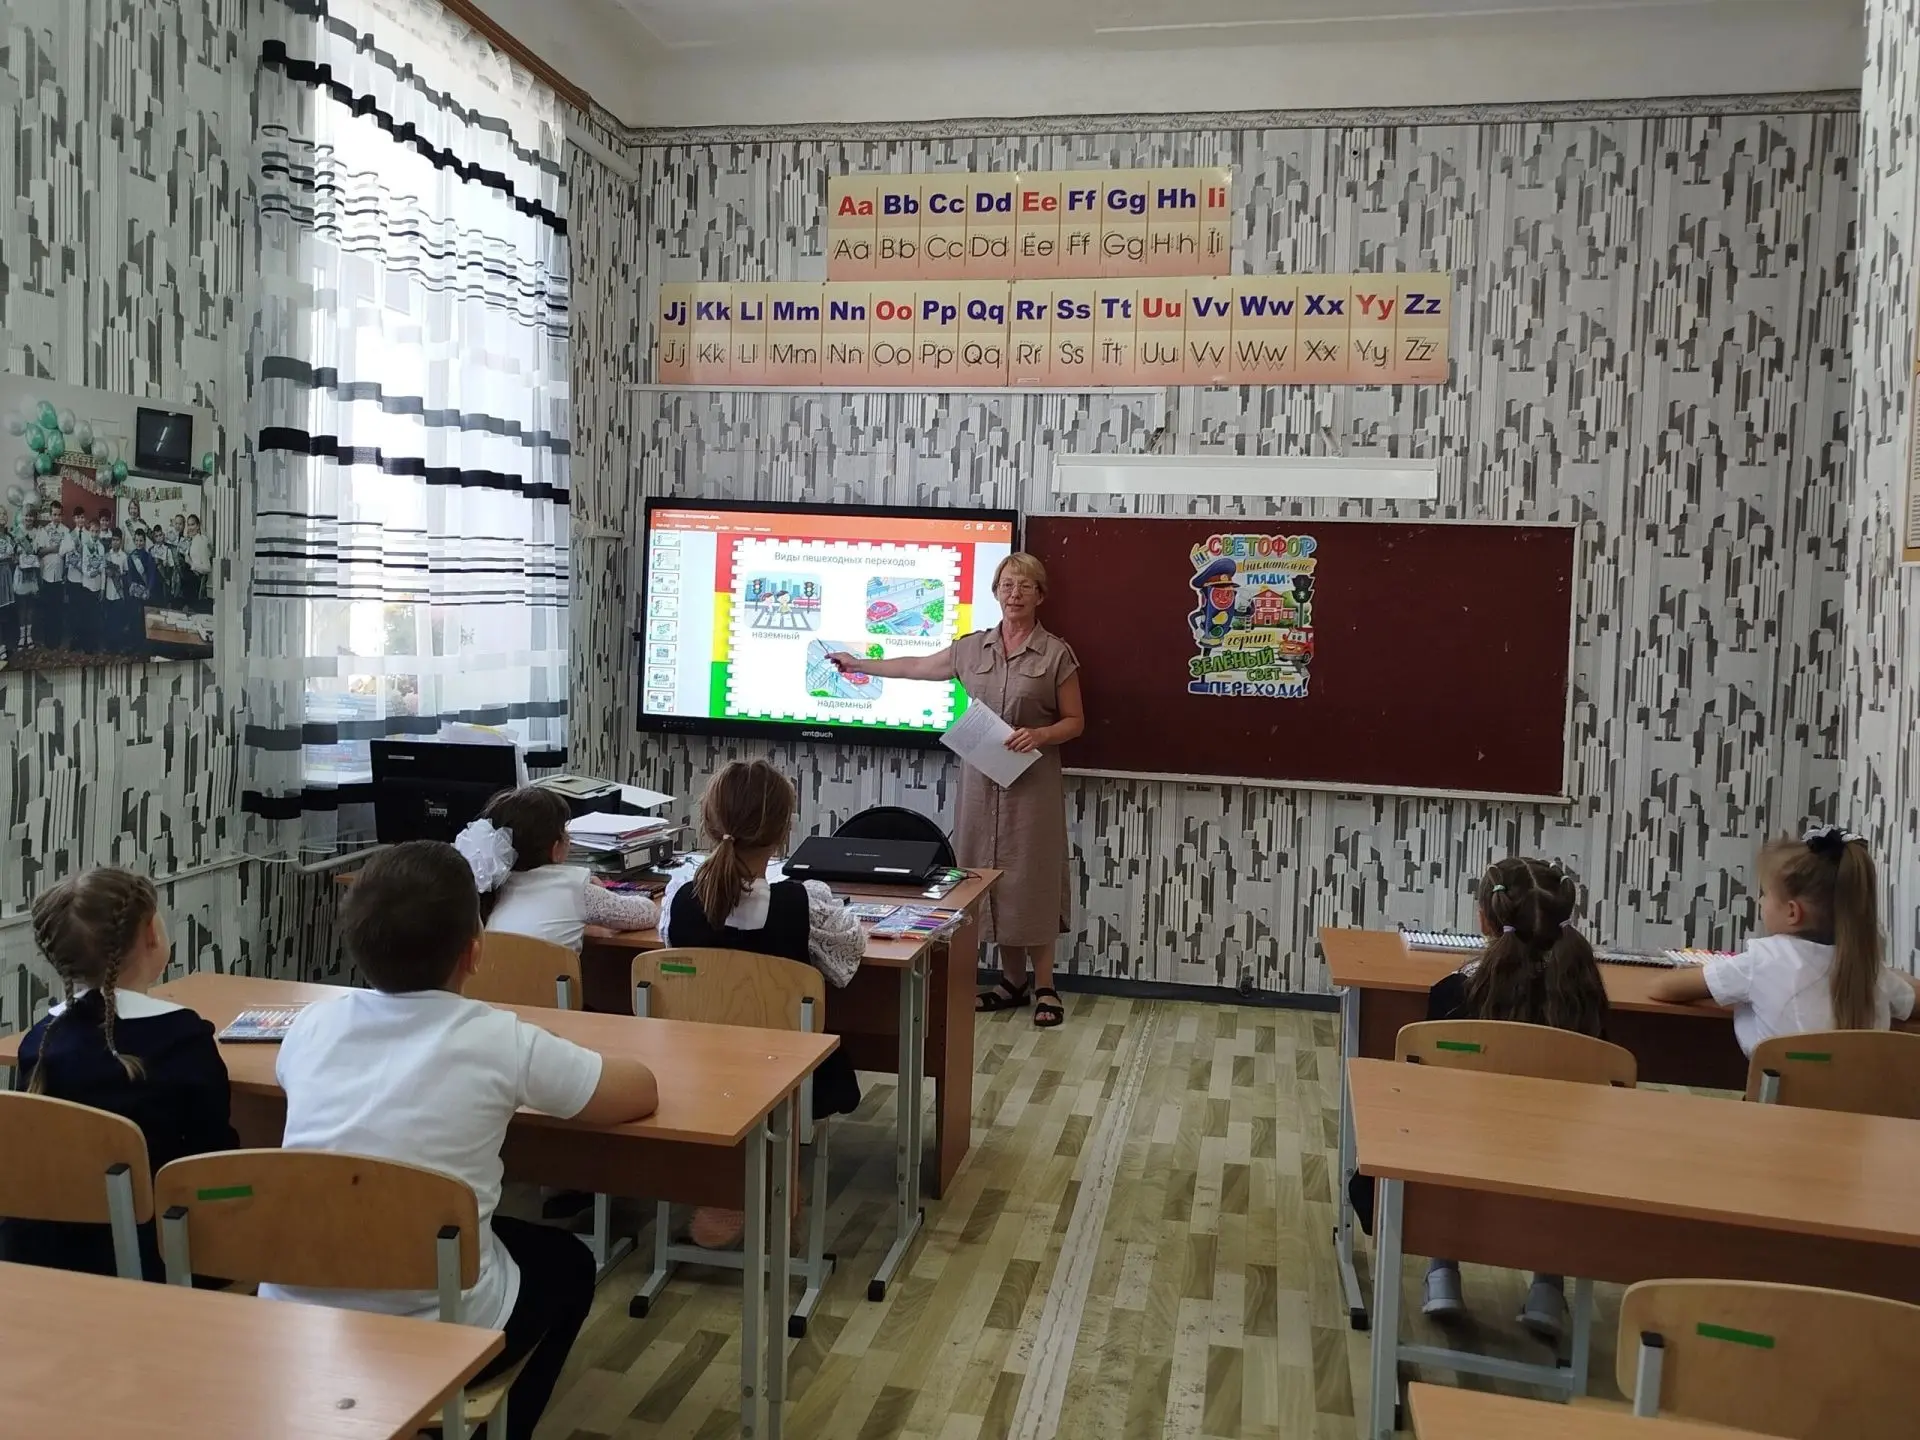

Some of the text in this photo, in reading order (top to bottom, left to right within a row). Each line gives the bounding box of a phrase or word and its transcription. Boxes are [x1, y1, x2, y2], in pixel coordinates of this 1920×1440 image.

[838, 187, 1225, 216] Aa Bb Cc Dd Ee Ff Gg Hh Ii
[834, 231, 1221, 260] Aa Bb Cc Dd Ee Ff Gg Hh Ii
[664, 295, 1441, 326] Jj Kk Ll Mm Nn Oo Pp Qq Rr Ss Tt Uu Vv Ww Xx Yy Zz
[664, 339, 1432, 369] Jj Kk Ll Mm Nn Oo Pp Qq Rr Ss Tt Uu Vv Ww Xx Yy Zz
[1208, 536, 1316, 558] СВЕТОФОР
[774, 552, 916, 568] Виды пешеходных переходов
[1246, 574, 1291, 585] ГЛЯДИ:
[752, 632, 800, 640] наземный
[885, 638, 942, 648] подземный
[1190, 646, 1275, 676] ЗЕЛЁНЫЙ
[1209, 676, 1309, 698] ПЕРЕХОДИ!
[817, 700, 873, 710] надземный
